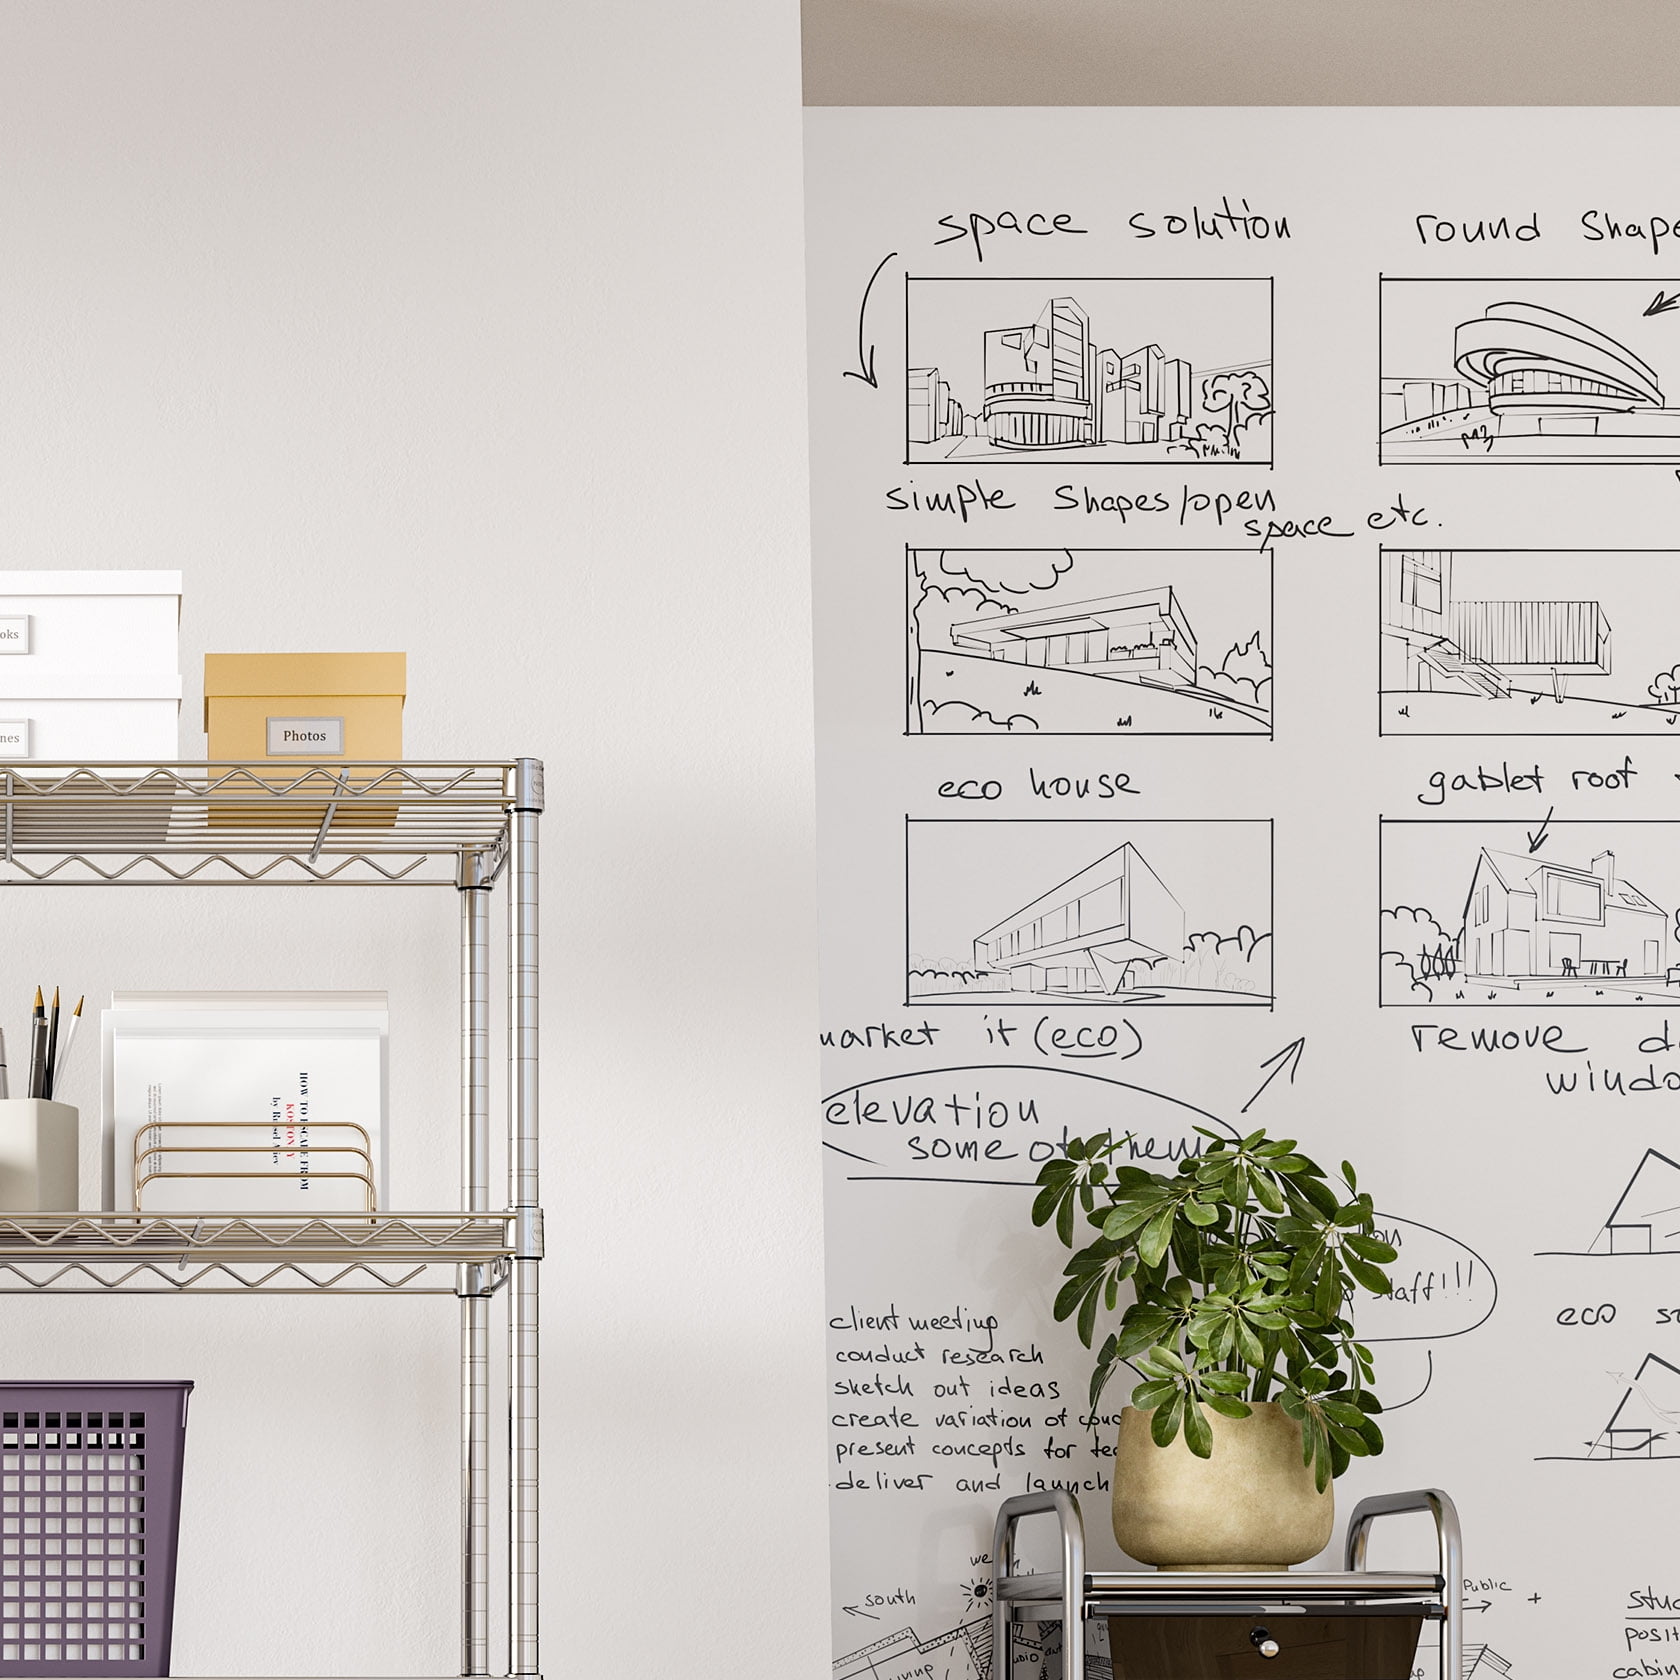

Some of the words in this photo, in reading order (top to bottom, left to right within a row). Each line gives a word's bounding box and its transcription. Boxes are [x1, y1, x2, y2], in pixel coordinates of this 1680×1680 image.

[933, 211, 1088, 262] space
[1128, 196, 1292, 239] solution
[1416, 212, 1541, 244] round
[885, 479, 1017, 523] simple
[1244, 515, 1355, 554] space
[1367, 492, 1444, 530] etc.
[282, 729, 327, 742] Photos
[937, 779, 1003, 801] eco
[1028, 767, 1141, 799] house
[1417, 760, 1545, 805] gablet
[1571, 755, 1639, 790] roof
[1411, 1024, 1589, 1054] remove
[300, 1072, 309, 1096] HOW
[300, 1102, 309, 1116] TO
[826, 1089, 1041, 1129] elevation
[907, 1135, 1019, 1162] some
[829, 1303, 900, 1331] client
[909, 1306, 999, 1352] meeting
[1556, 1303, 1617, 1326] eco
[836, 1341, 926, 1364] conduct
[942, 1343, 1044, 1367] research
[833, 1373, 914, 1397] sketch
[933, 1375, 971, 1398] out
[990, 1376, 1061, 1400] ideas
[832, 1405, 920, 1429] create
[935, 1404, 1032, 1429] variation
[1044, 1407, 1069, 1428] of
[835, 1435, 917, 1464] present
[931, 1435, 1026, 1469] concepts
[1043, 1435, 1078, 1460] for
[834, 1470, 934, 1492] deliver
[955, 1473, 1001, 1493] and
[1025, 1471, 1110, 1494] launch
[864, 1587, 917, 1608] south
